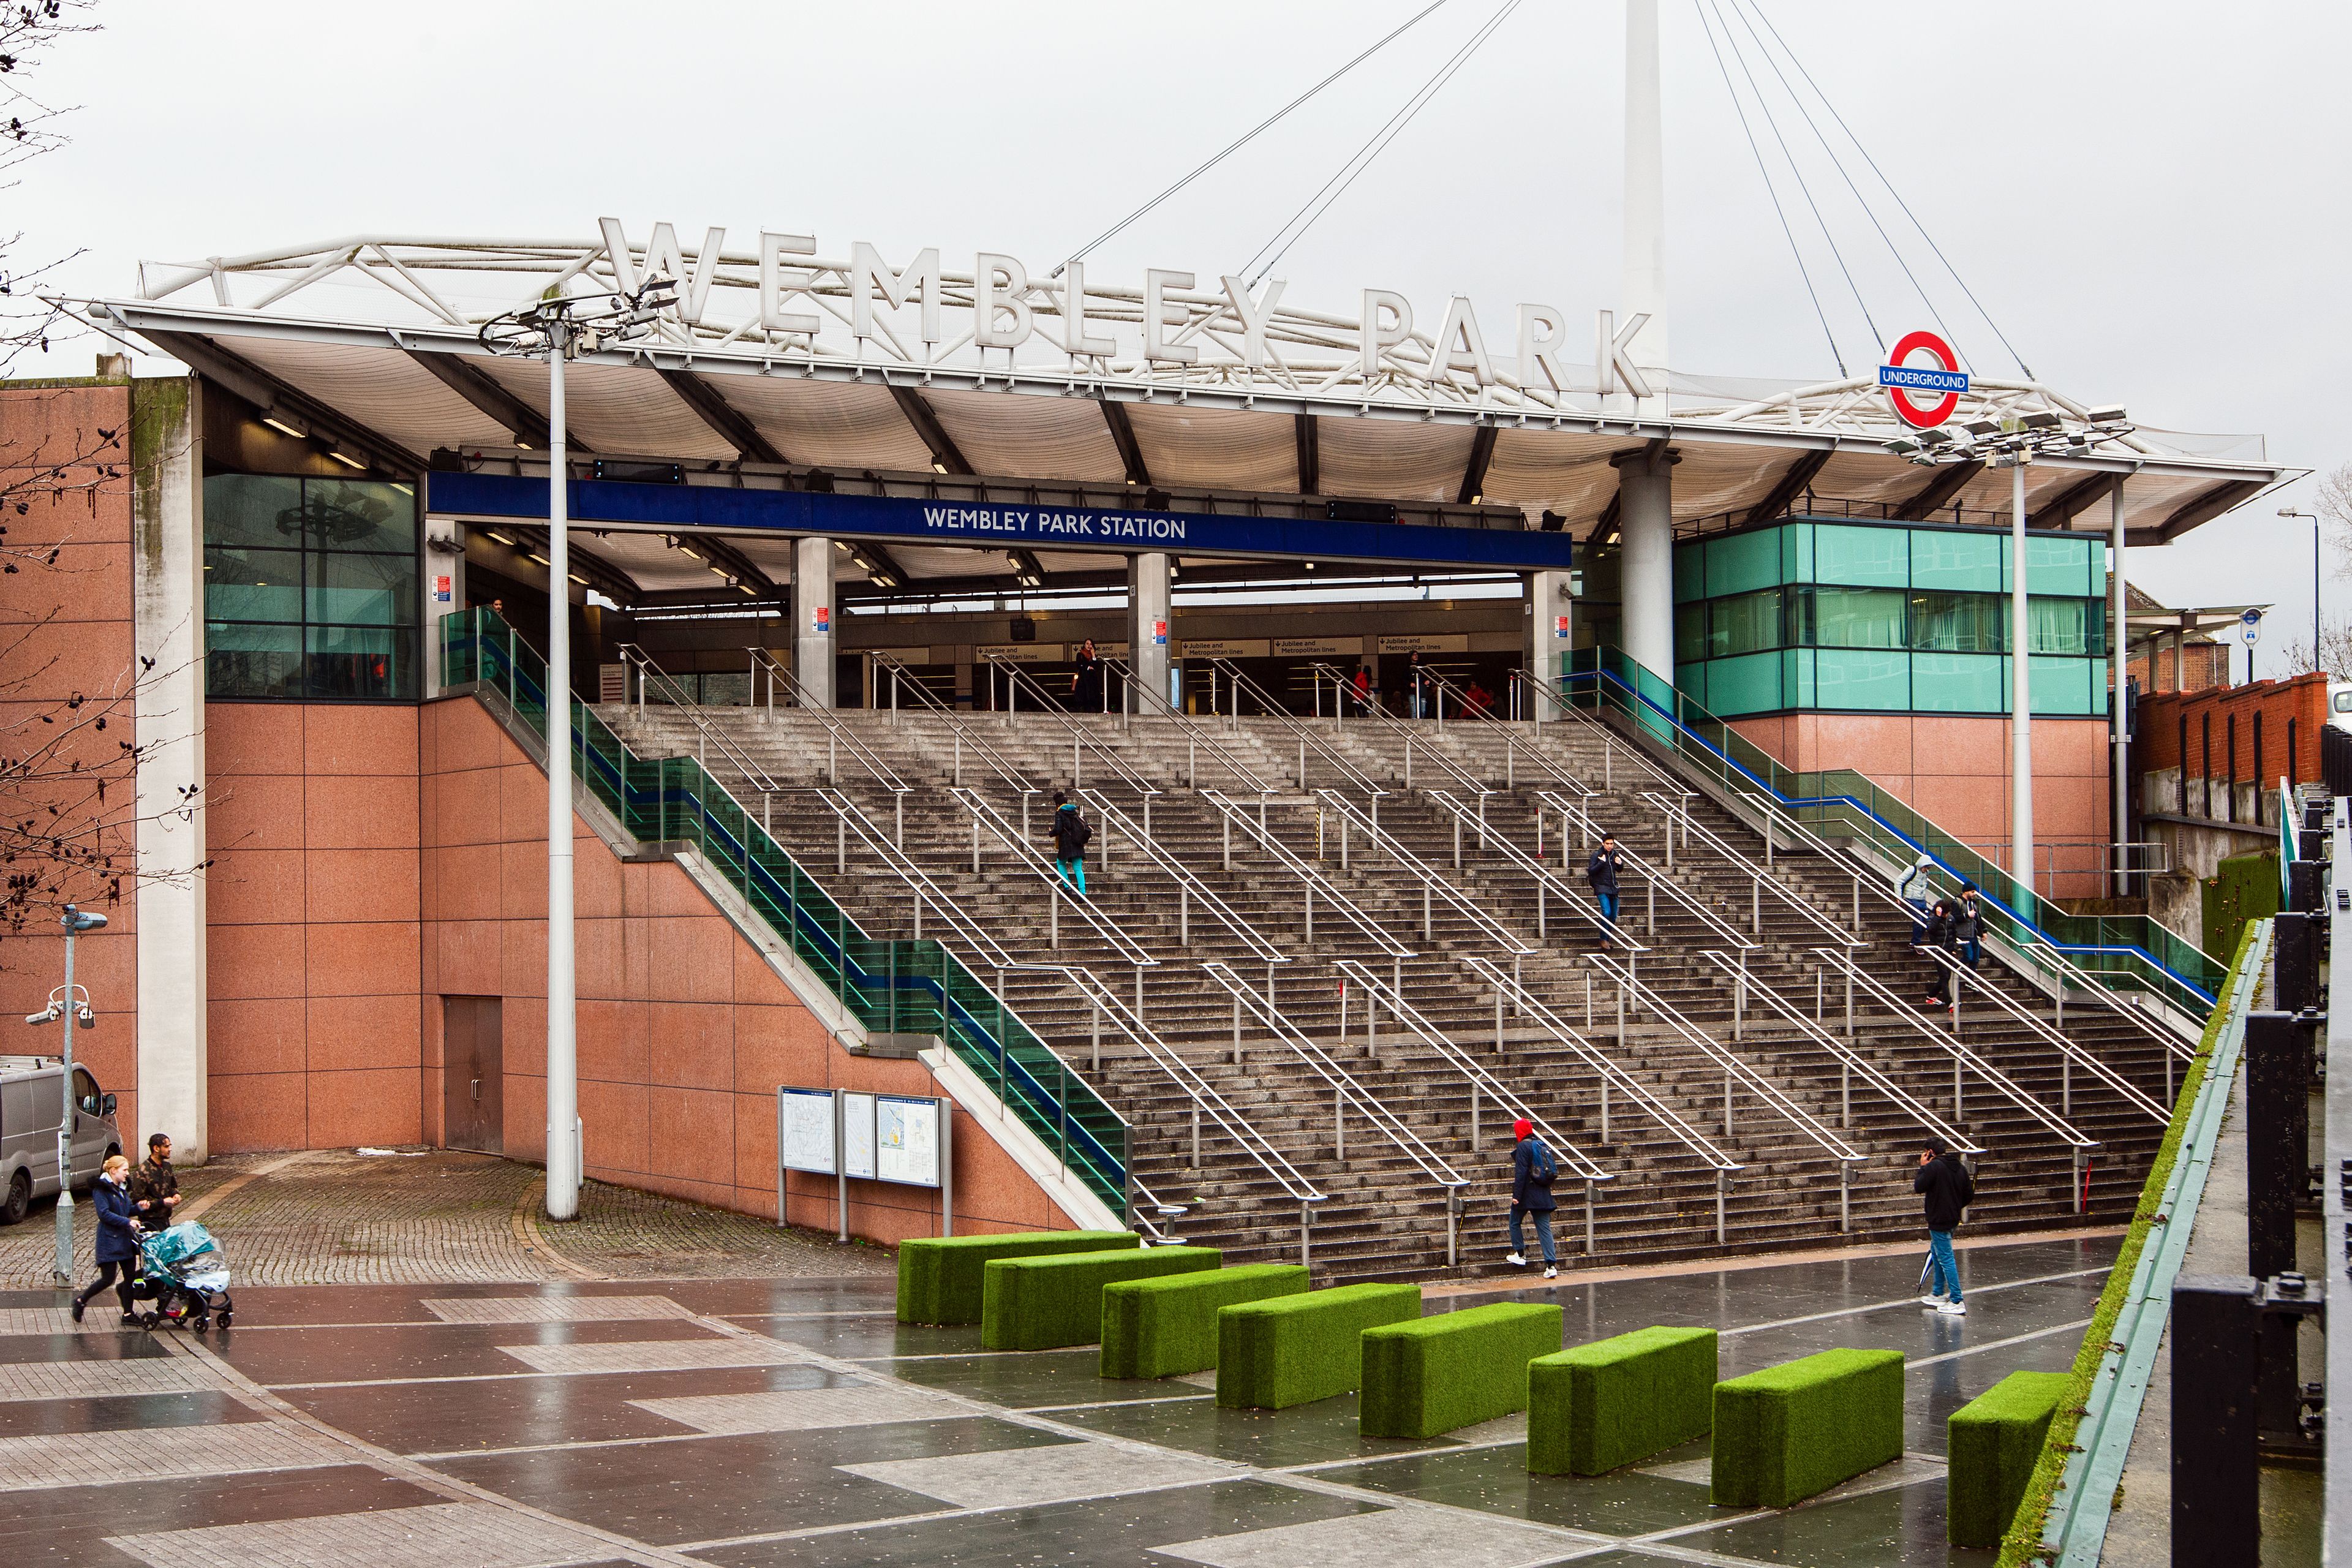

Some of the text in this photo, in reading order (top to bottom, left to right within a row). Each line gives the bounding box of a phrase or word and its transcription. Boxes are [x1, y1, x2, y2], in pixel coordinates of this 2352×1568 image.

[598, 216, 1654, 398] WEMBLEY PARK
[1883, 370, 1966, 388] UNDERGROUND
[924, 508, 1185, 539] WEMBLEY PARK STATION
